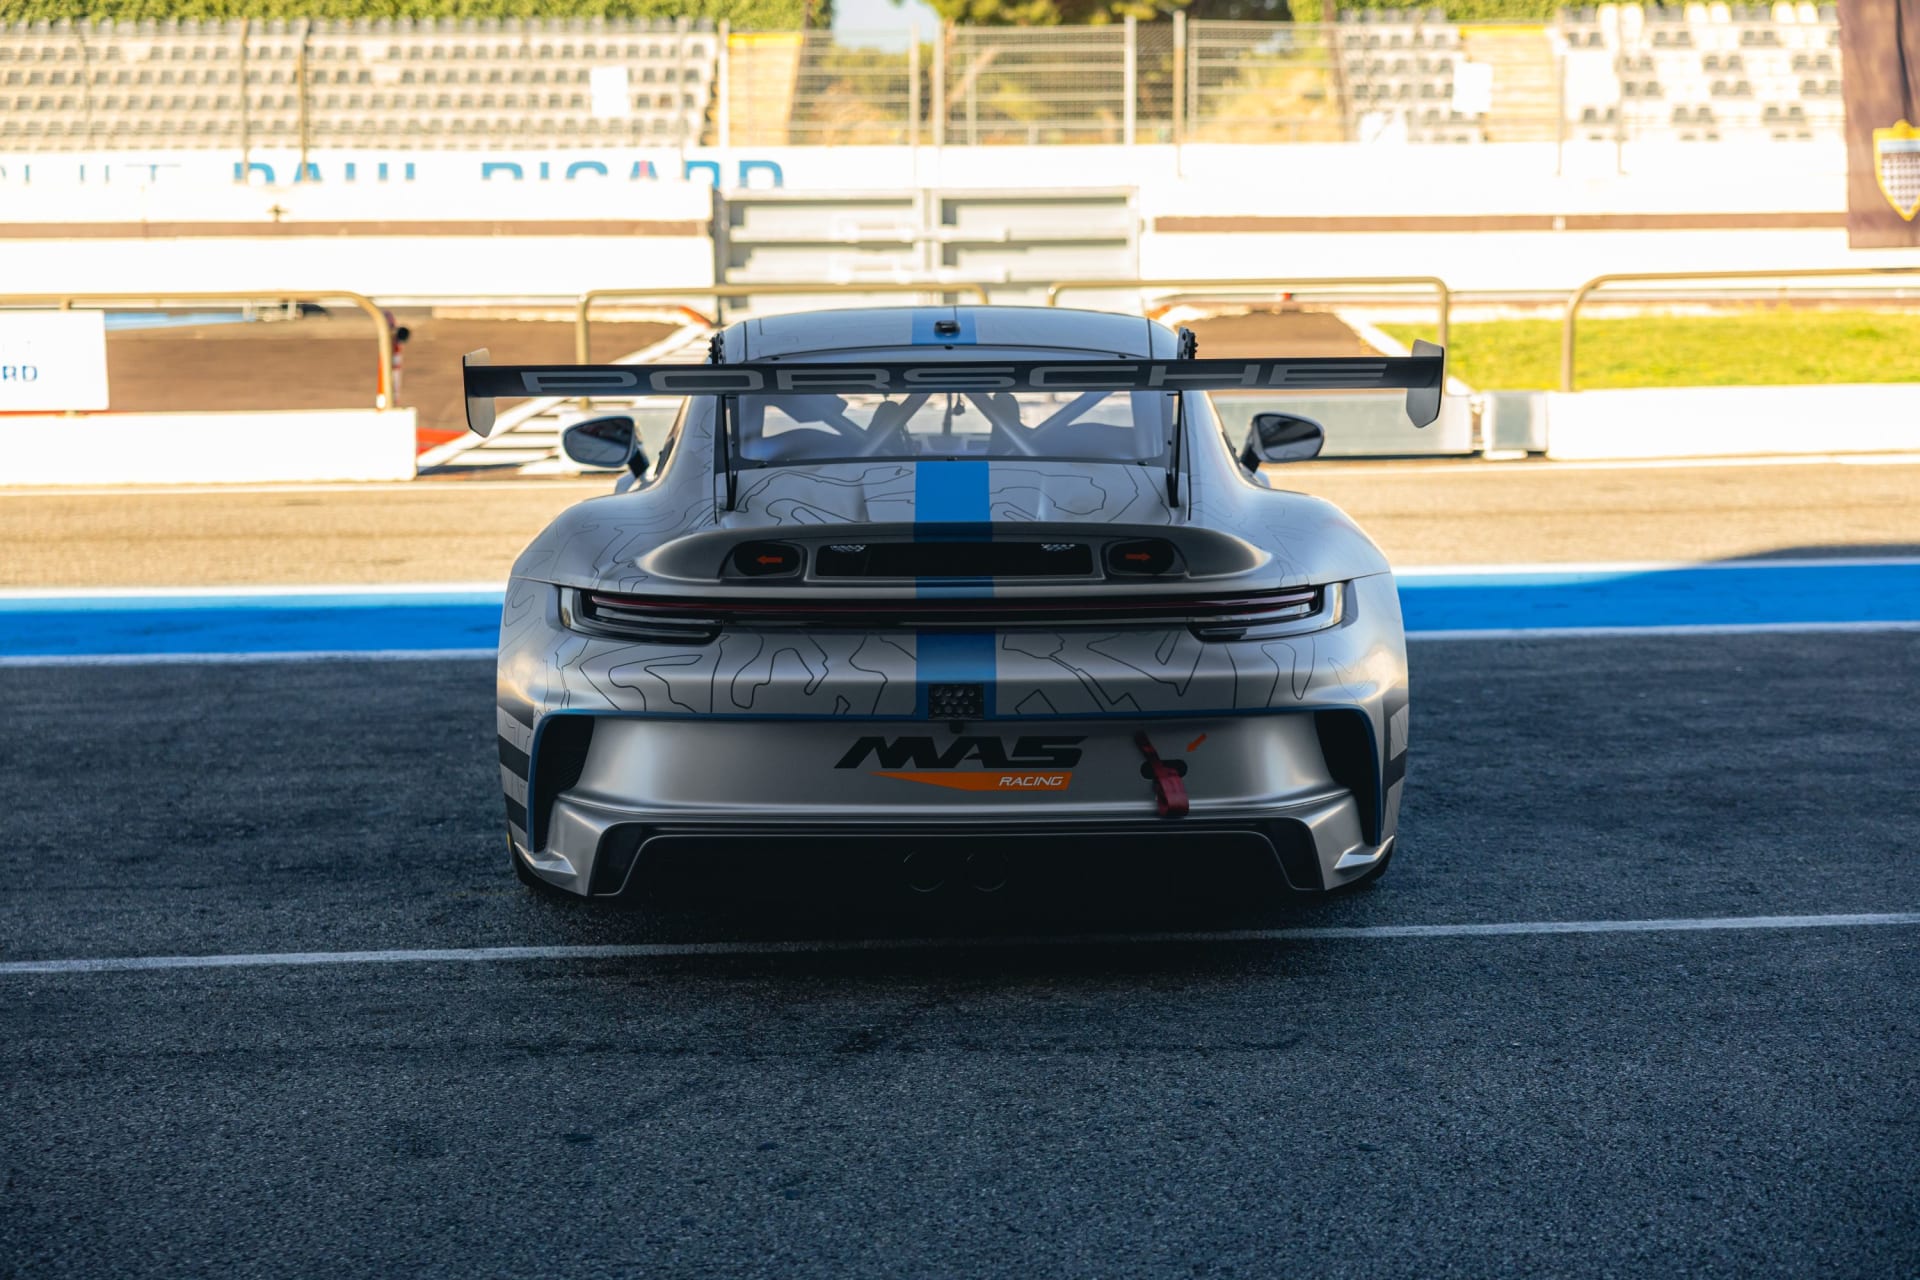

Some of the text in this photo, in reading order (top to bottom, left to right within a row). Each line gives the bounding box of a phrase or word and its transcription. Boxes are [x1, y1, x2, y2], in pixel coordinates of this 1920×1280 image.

[520, 363, 1388, 393] PORSCHE
[833, 735, 1089, 769] MAS
[998, 775, 1065, 787] RACING
